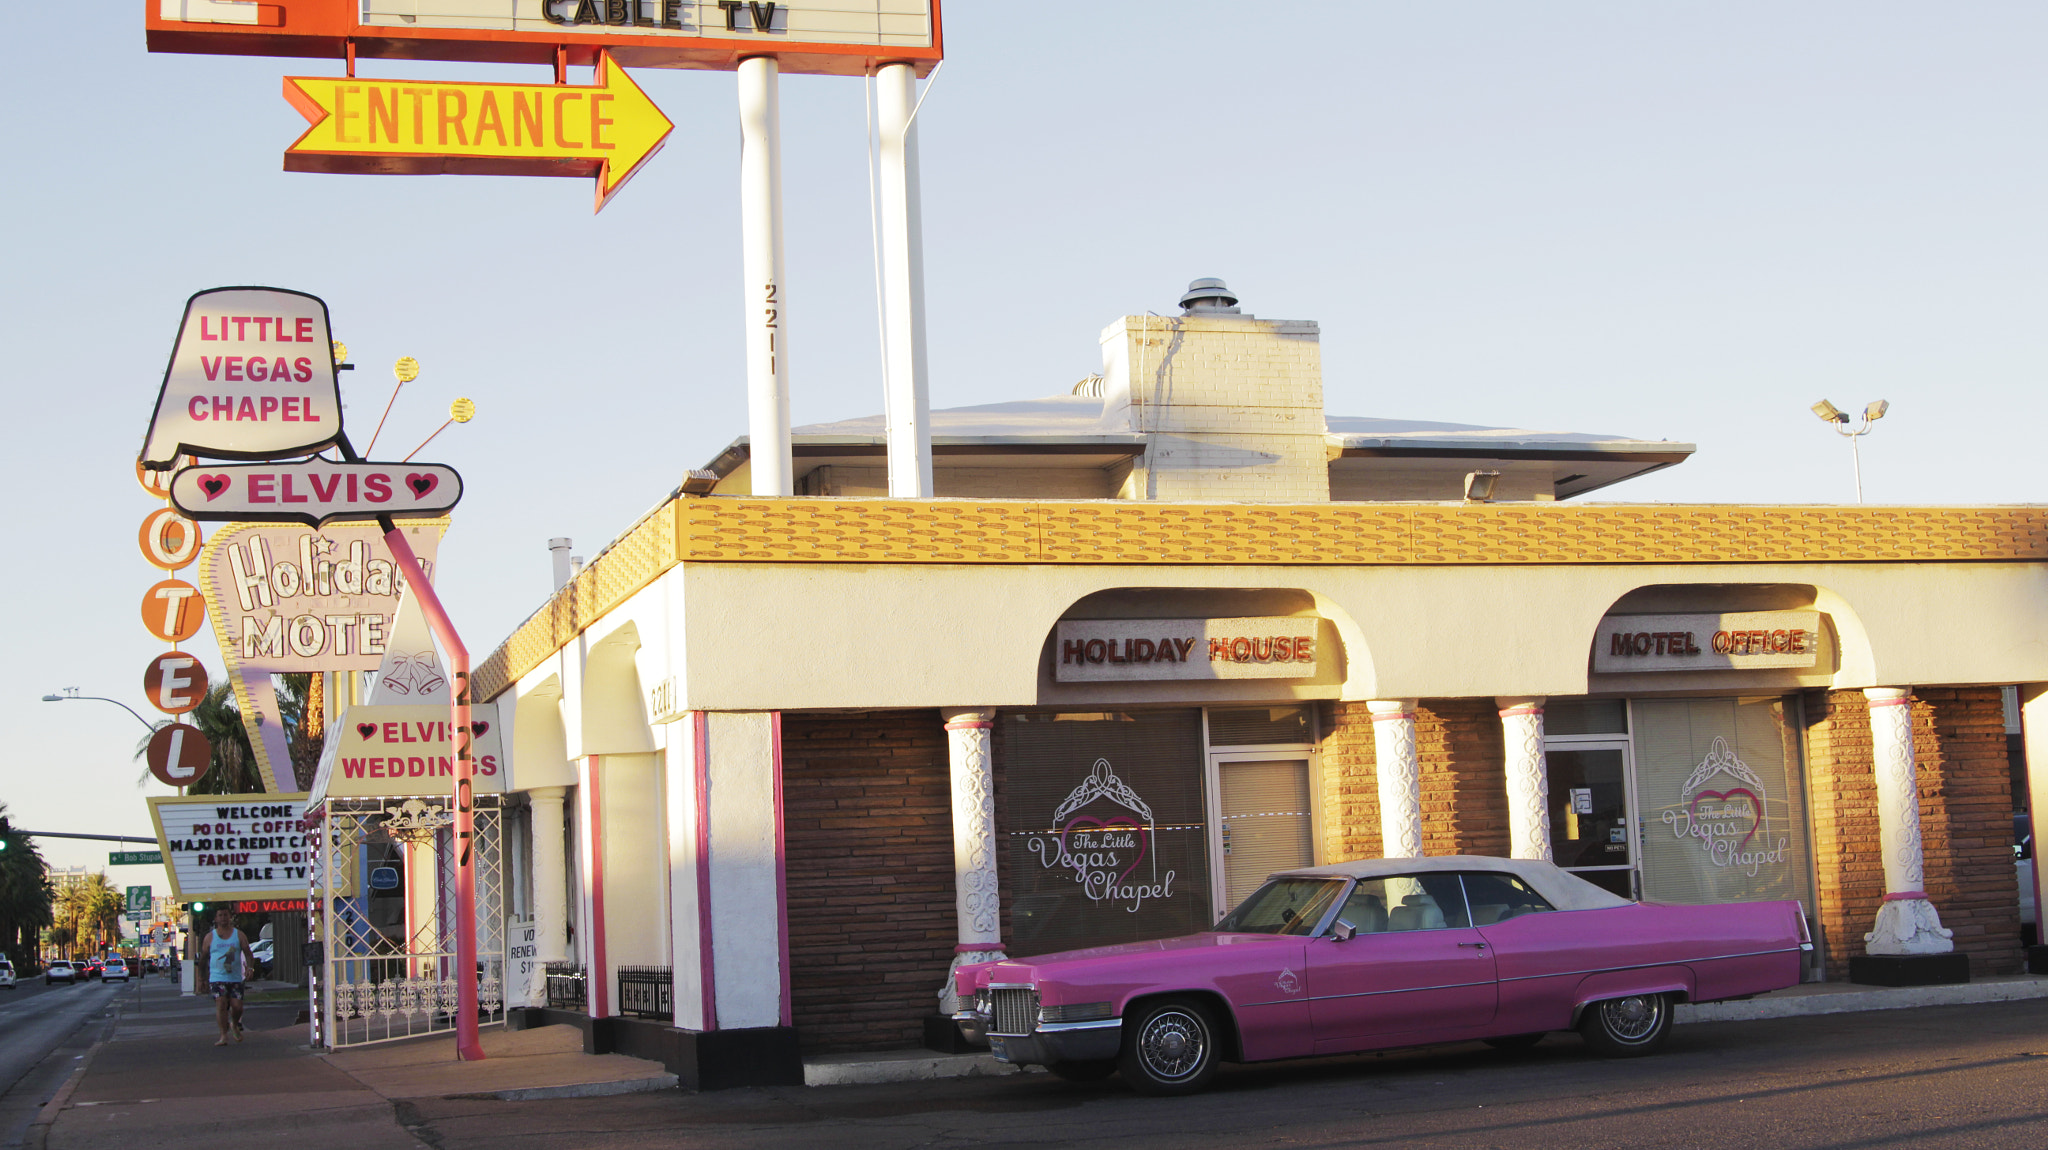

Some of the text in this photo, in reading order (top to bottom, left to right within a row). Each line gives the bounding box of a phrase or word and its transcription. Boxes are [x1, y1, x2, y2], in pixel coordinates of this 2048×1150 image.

[542, 0, 775, 33] CABLE TV
[334, 86, 617, 151] ENTRANCE
[200, 316, 314, 342] LITTLE
[765, 284, 778, 376] 2211
[200, 356, 313, 383] VEGAS
[188, 396, 320, 422] CHAPEL
[247, 473, 393, 503] ELVIS
[242, 614, 396, 658] MOTE
[1611, 629, 1806, 656] MOTEL OFFICE
[1063, 636, 1313, 664] HOLIDAY HOUSE
[453, 672, 474, 866] 2207
[217, 805, 292, 819] WELCOME
[1700, 804, 1751, 820] The Little
[1073, 833, 1136, 849] The Little
[1662, 810, 1738, 850] Vegas
[198, 851, 307, 866] FAMILY ROO
[1028, 837, 1120, 882] Vegas
[1711, 837, 1786, 877] Chapel
[222, 866, 306, 881] CABLE TV
[1084, 870, 1175, 912] Chapel
[239, 900, 323, 913] NO VACANY
[520, 961, 534, 974] $1
